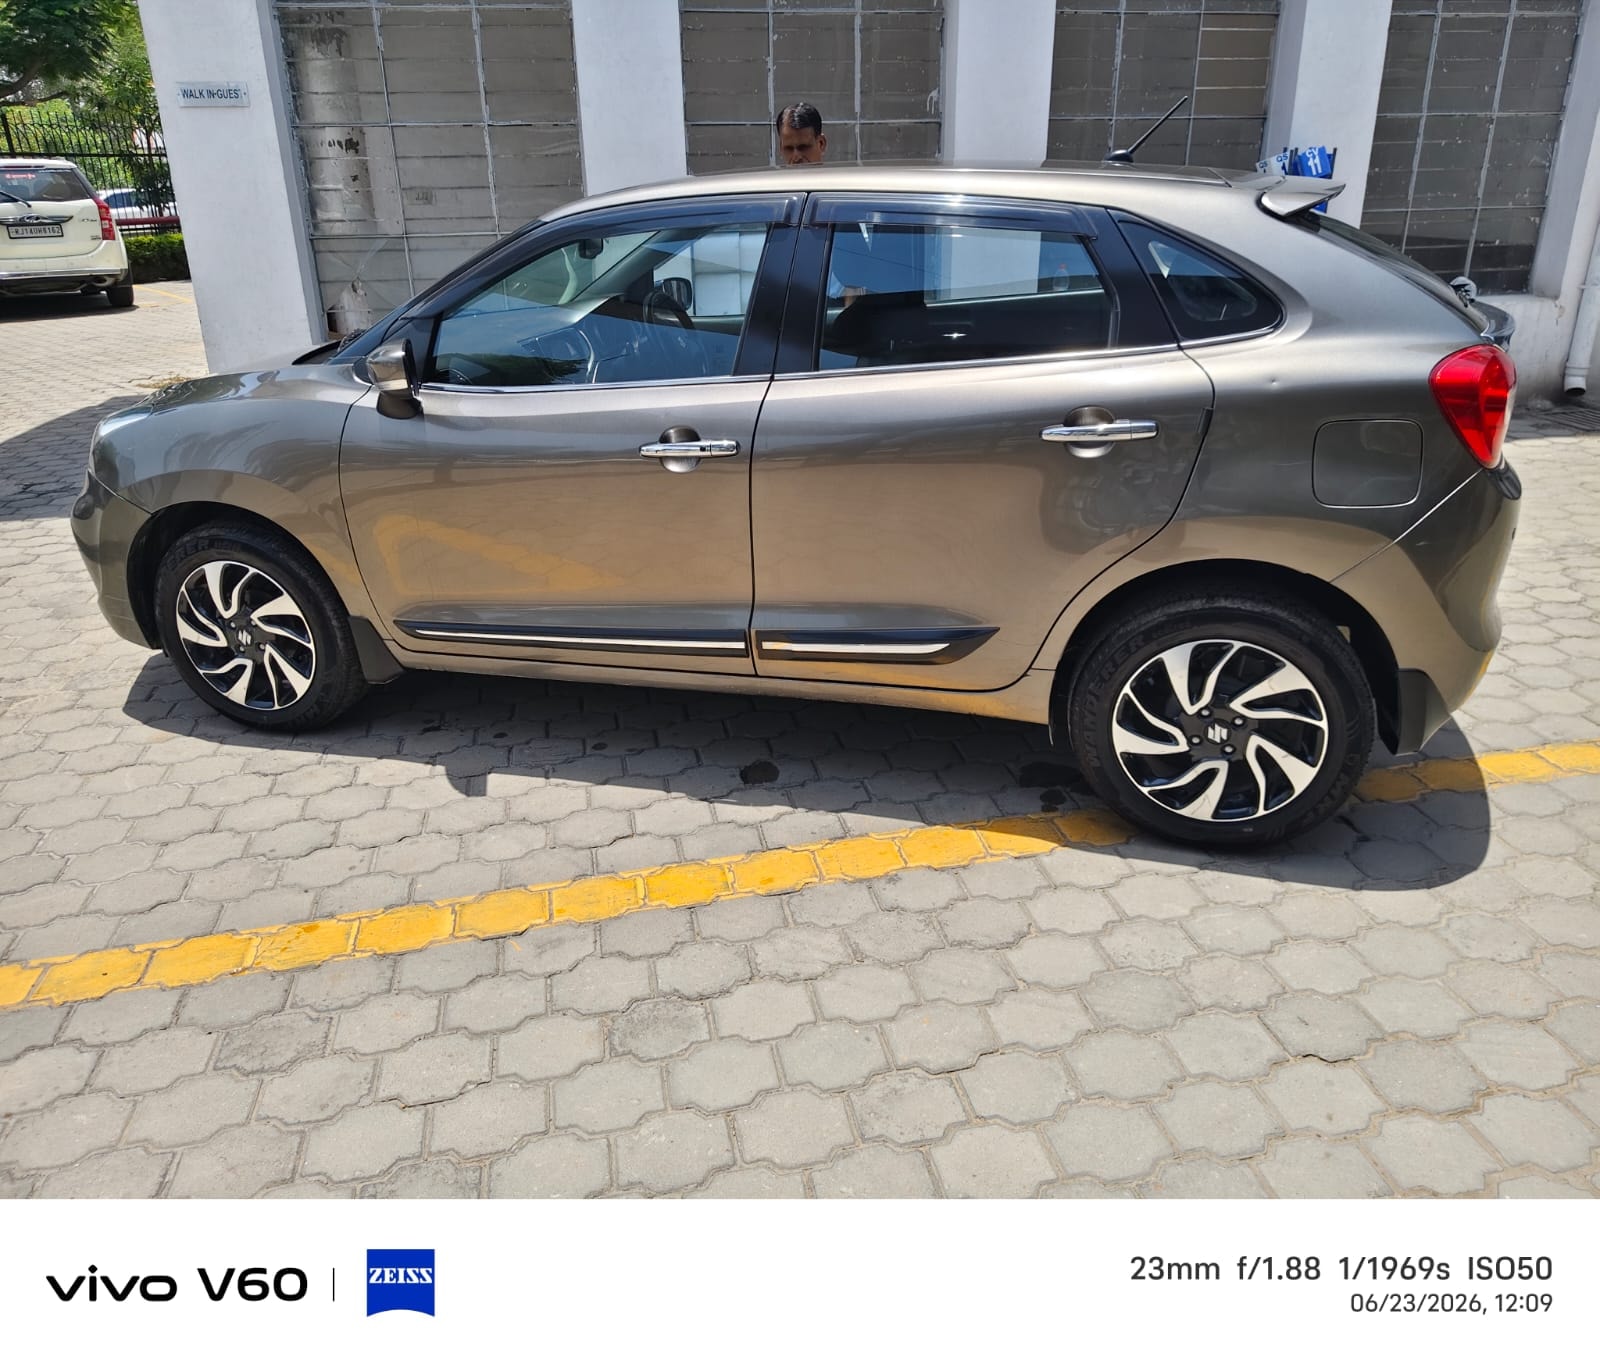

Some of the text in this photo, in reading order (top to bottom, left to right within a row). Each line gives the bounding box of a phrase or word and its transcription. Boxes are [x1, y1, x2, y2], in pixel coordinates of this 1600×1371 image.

[181, 89, 242, 99] WALK IN-GUES
[1308, 155, 1323, 177] 11
